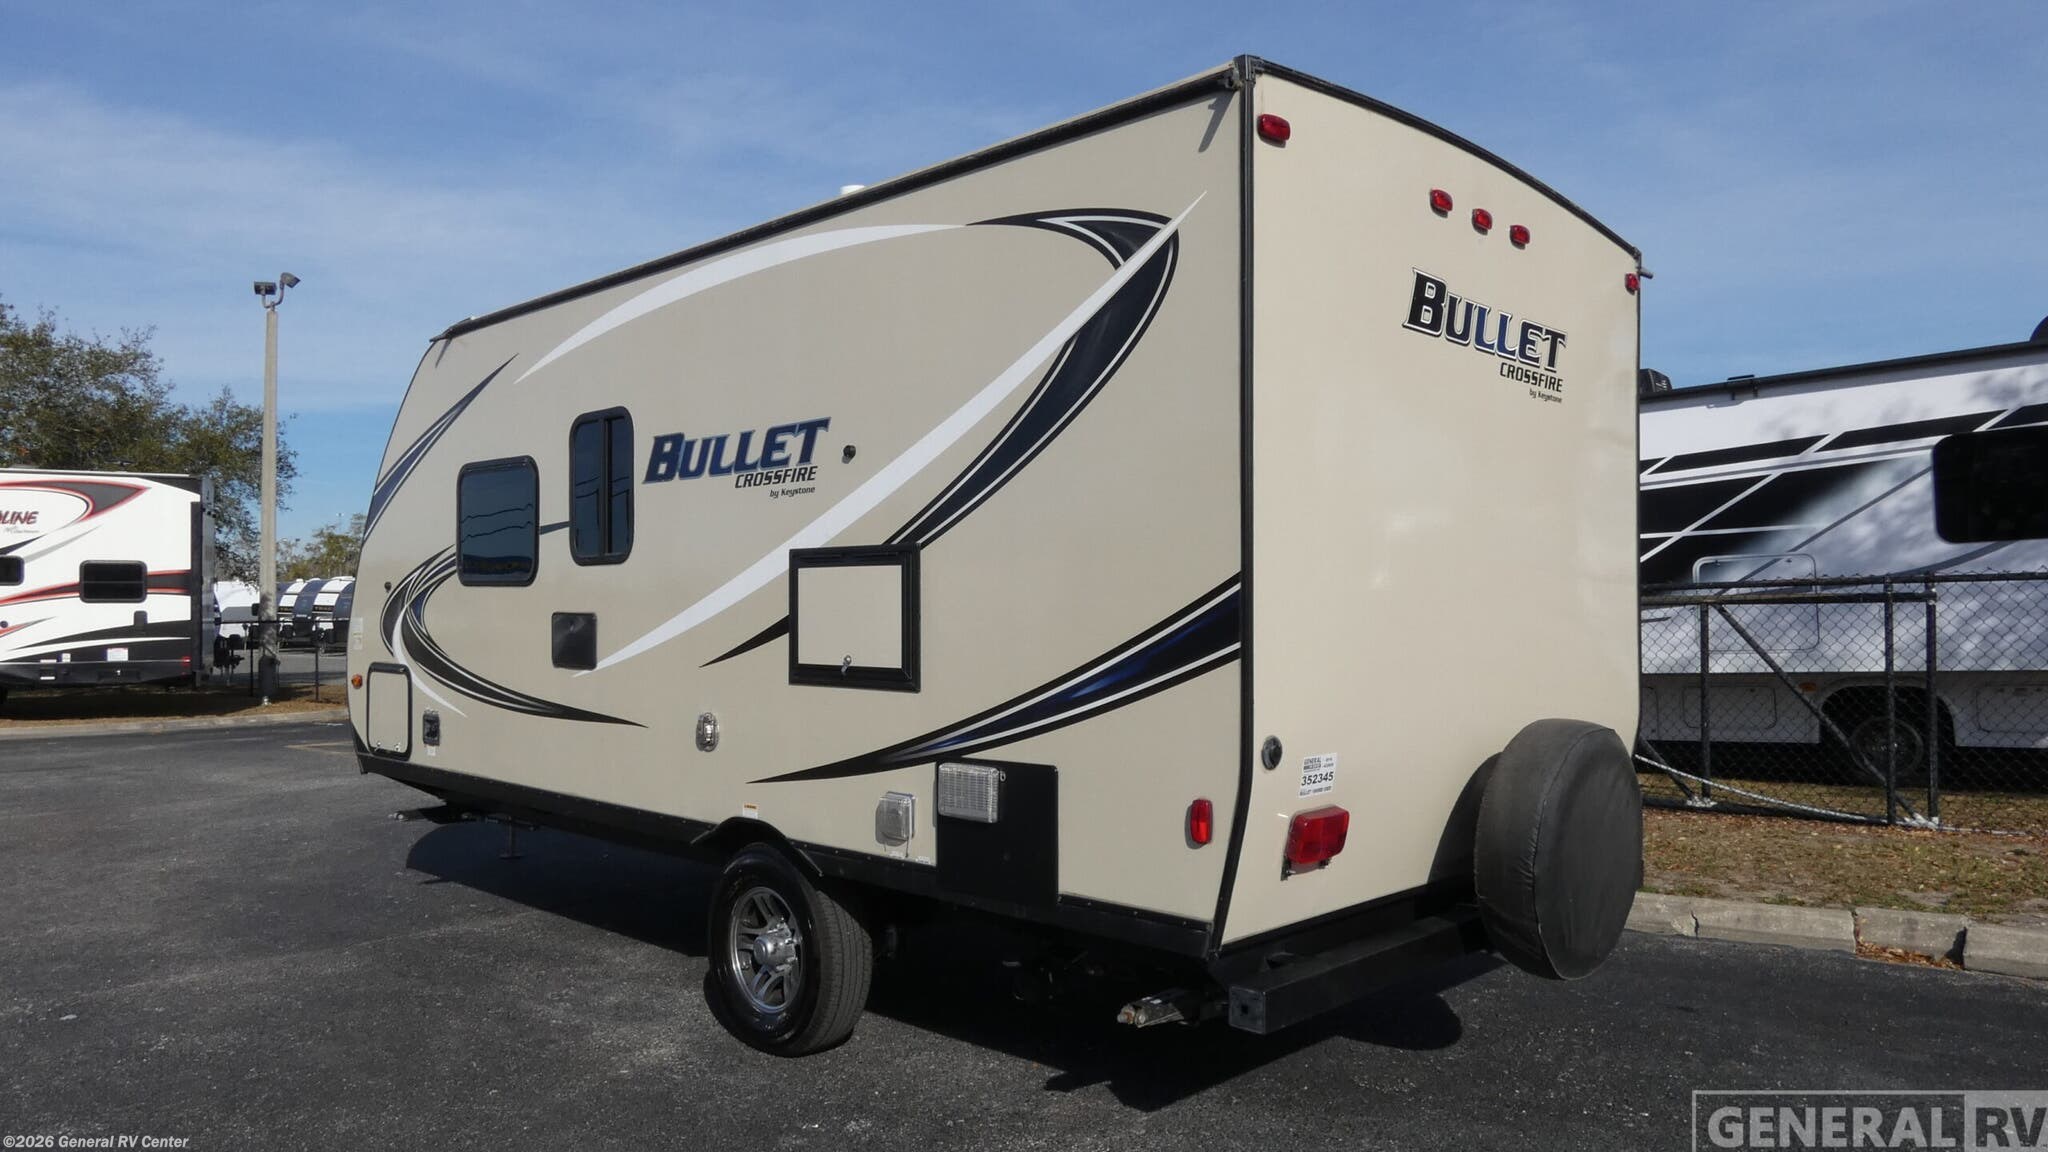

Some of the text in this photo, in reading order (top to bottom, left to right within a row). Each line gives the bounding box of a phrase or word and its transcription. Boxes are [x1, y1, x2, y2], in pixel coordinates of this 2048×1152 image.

[1402, 266, 1568, 373] BULLET
[1499, 362, 1564, 393] CROSSFIRE
[642, 416, 832, 485] BULLET
[734, 465, 818, 489] CROSSFIRE
[769, 486, 816, 499] by Keystone
[0, 510, 39, 525] LINE
[1301, 771, 1334, 787] 352345
